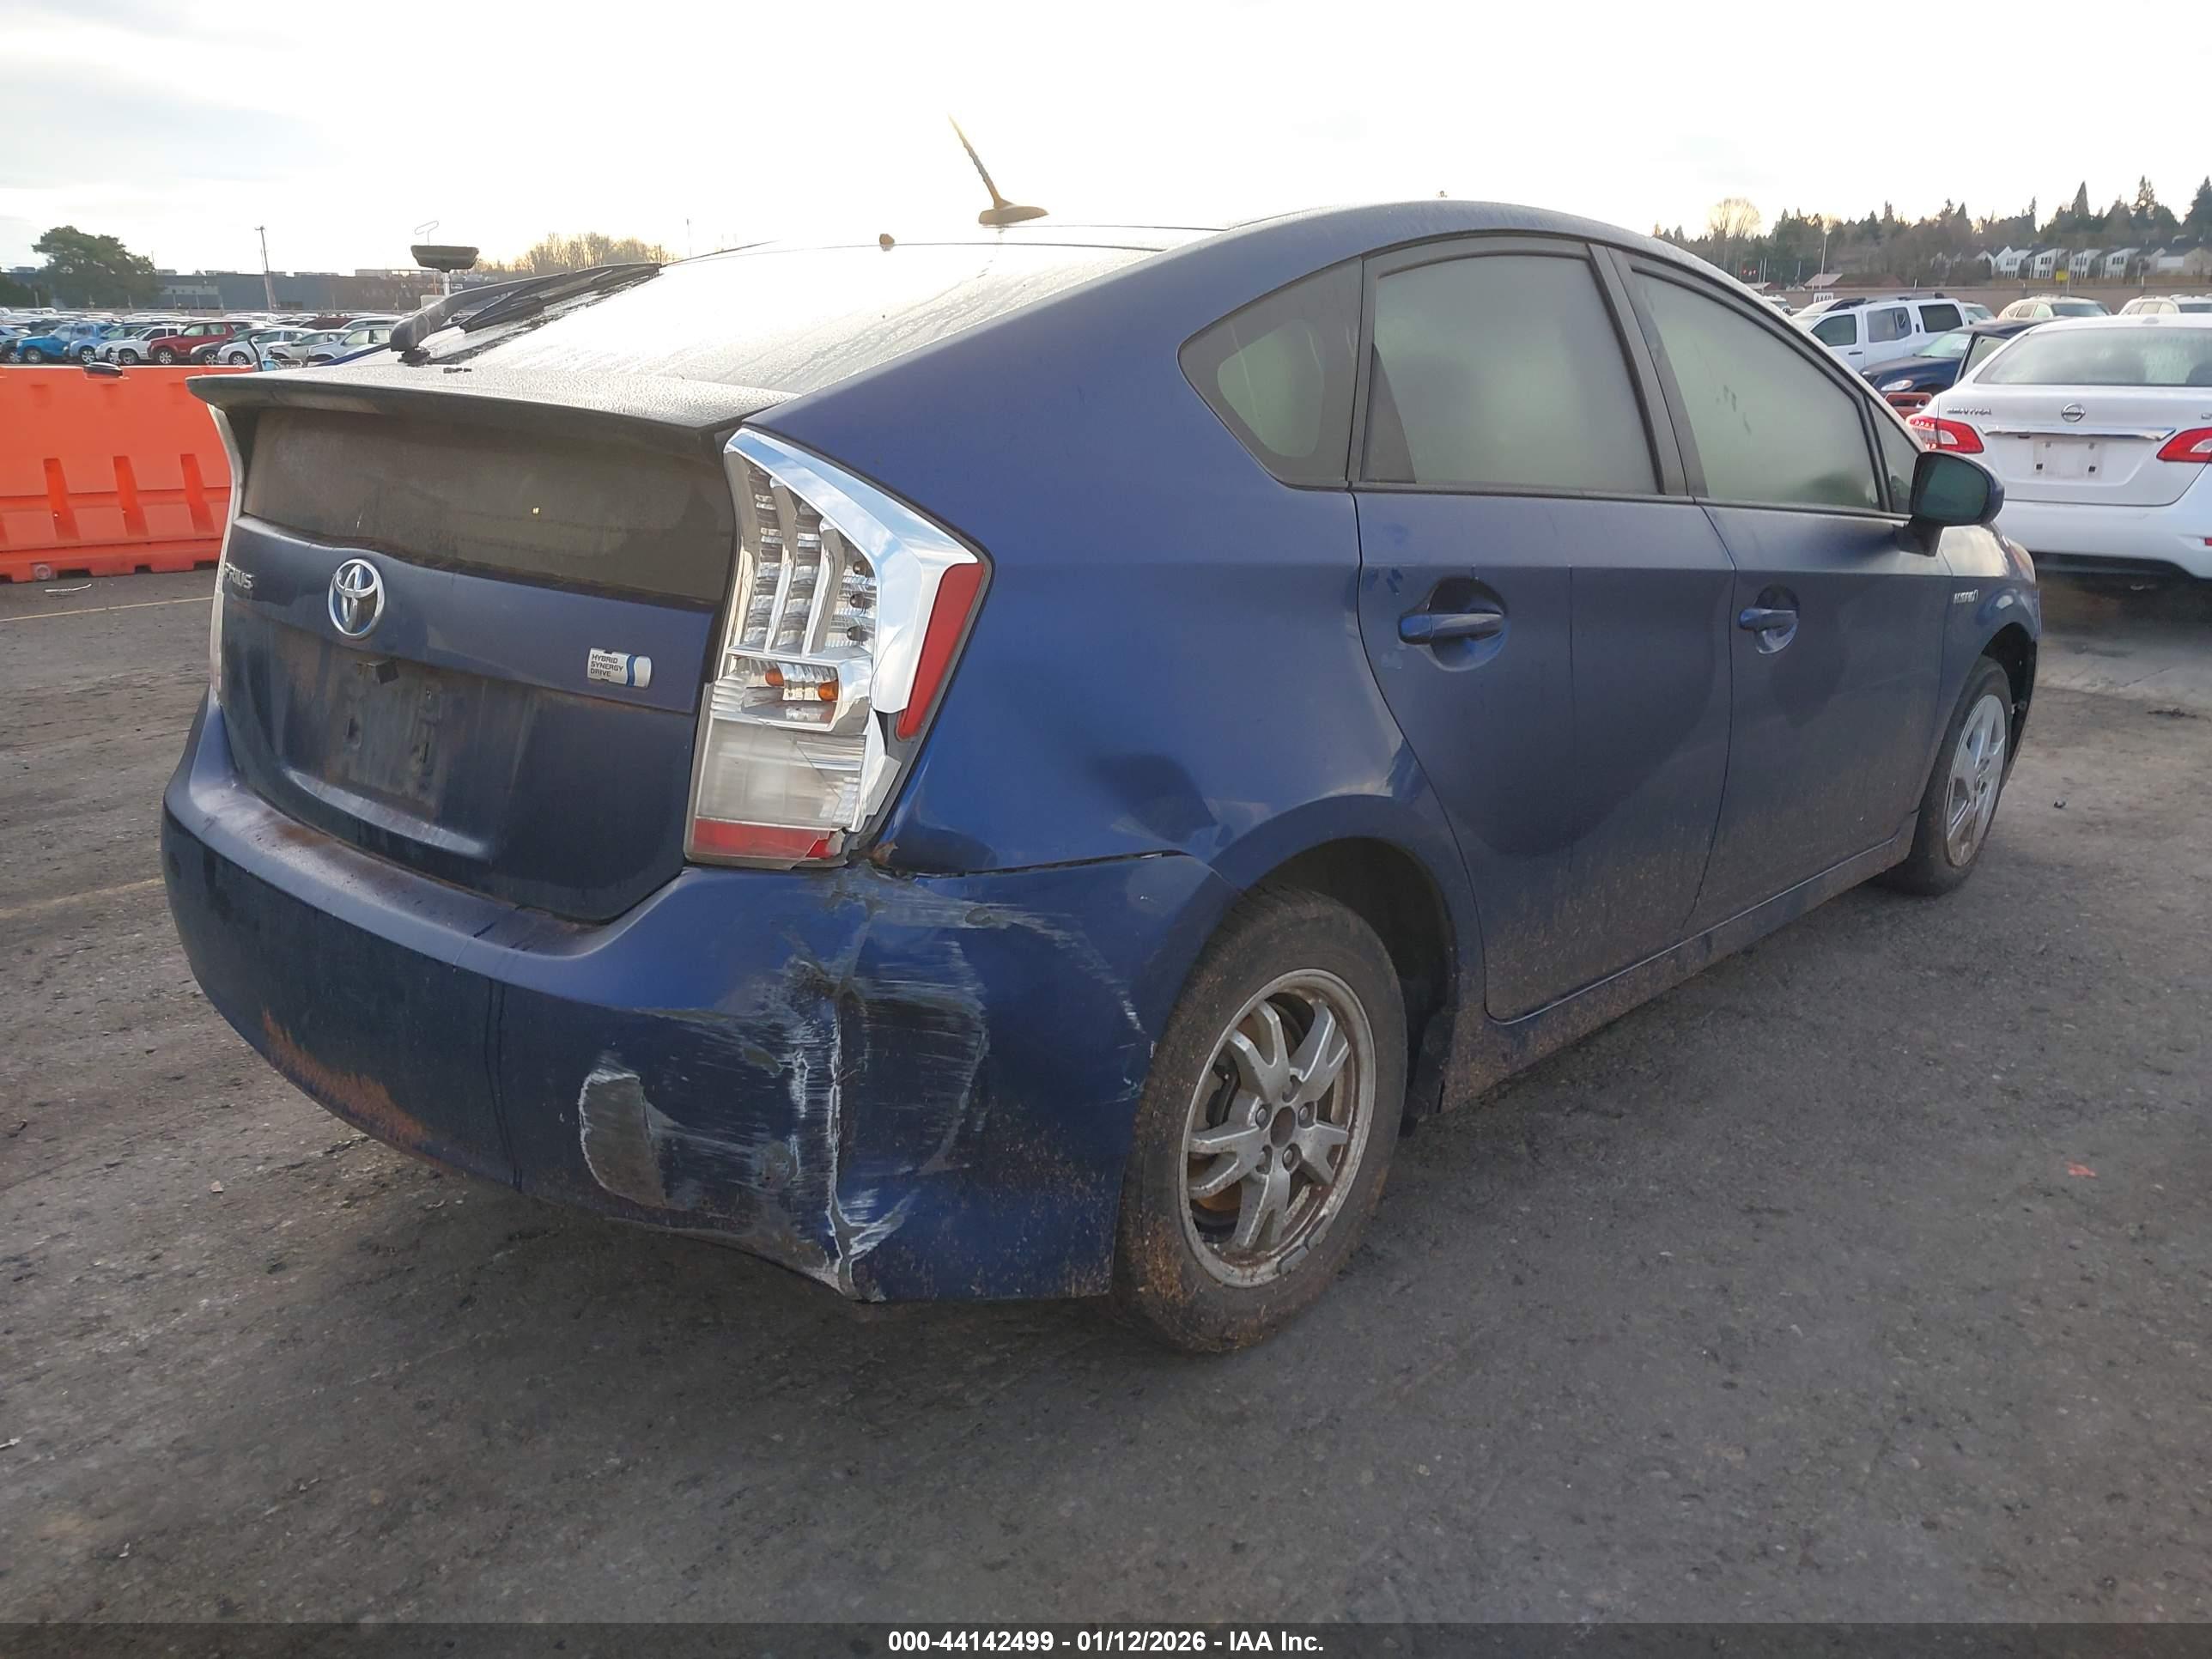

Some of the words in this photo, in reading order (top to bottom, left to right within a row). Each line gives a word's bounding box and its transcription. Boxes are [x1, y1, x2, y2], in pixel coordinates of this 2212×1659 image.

[592, 653, 618, 664] HYBRID
[590, 660, 624, 672] SYNERGY
[590, 668, 611, 678] DRIVE
